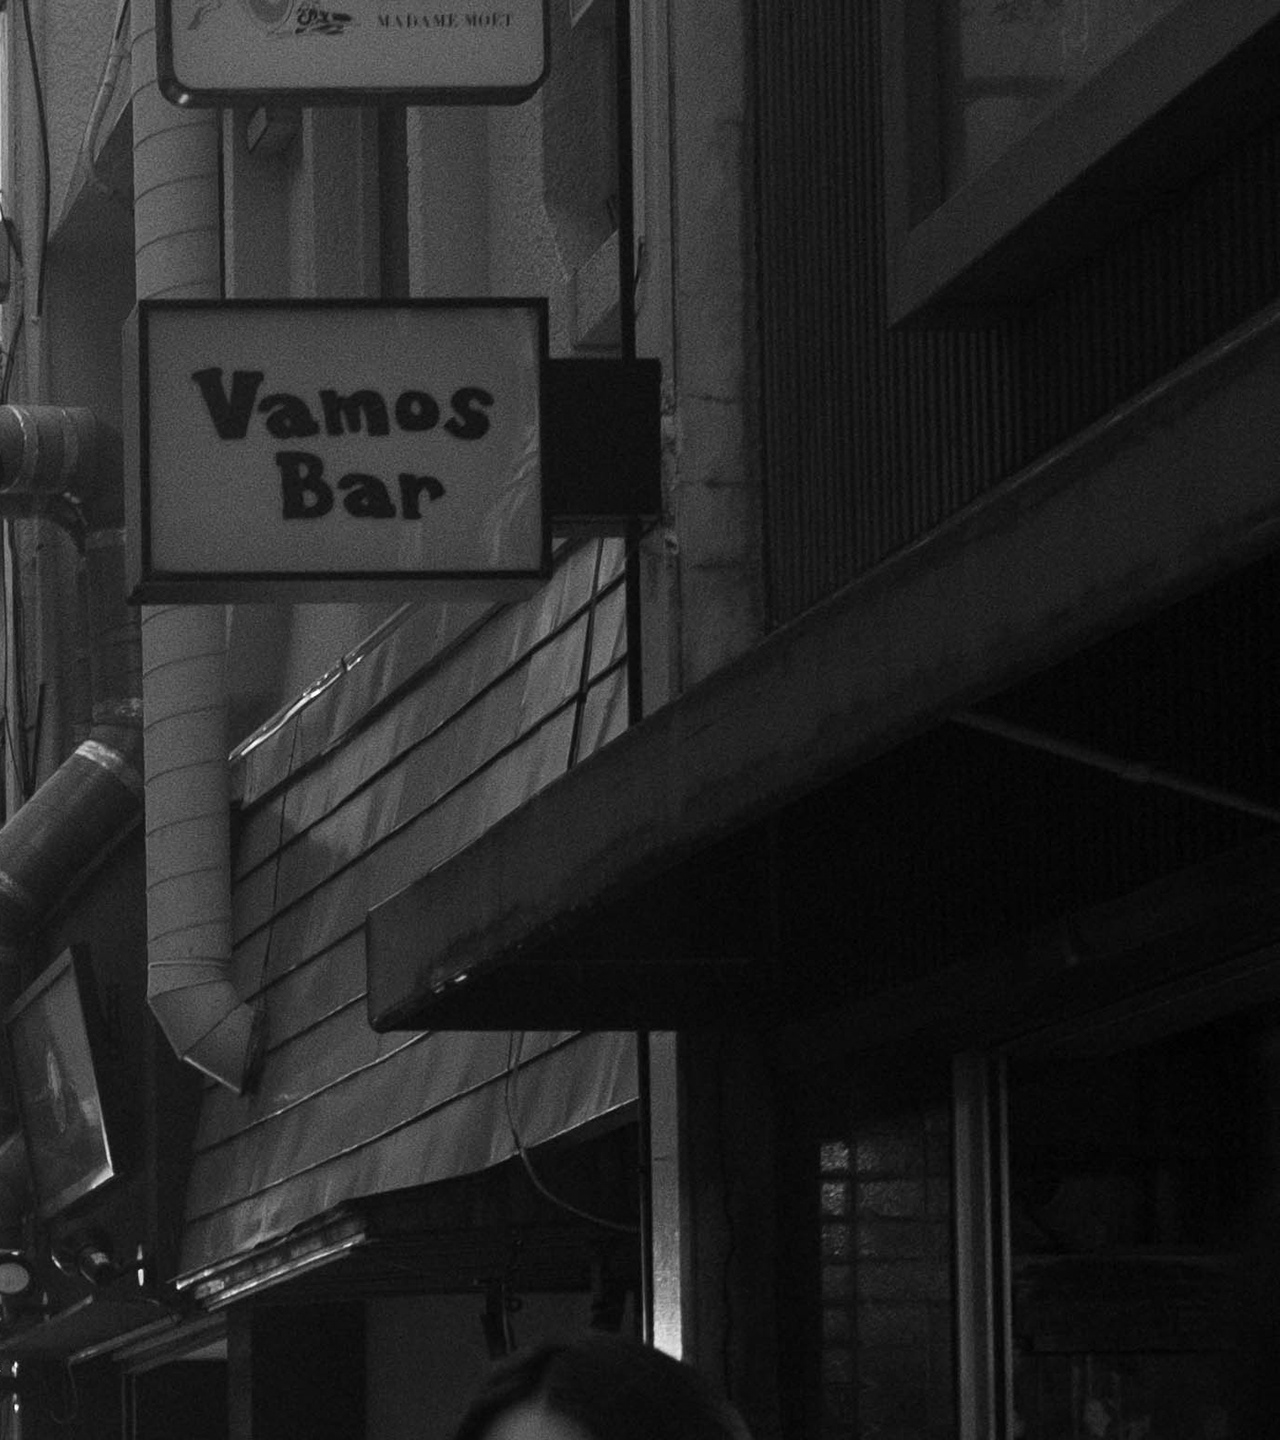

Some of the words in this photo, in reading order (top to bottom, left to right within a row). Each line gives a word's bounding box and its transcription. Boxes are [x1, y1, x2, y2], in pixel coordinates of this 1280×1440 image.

[378, 13, 459, 29] MADAME
[191, 367, 495, 441] Vamos
[276, 450, 444, 520] Bar
